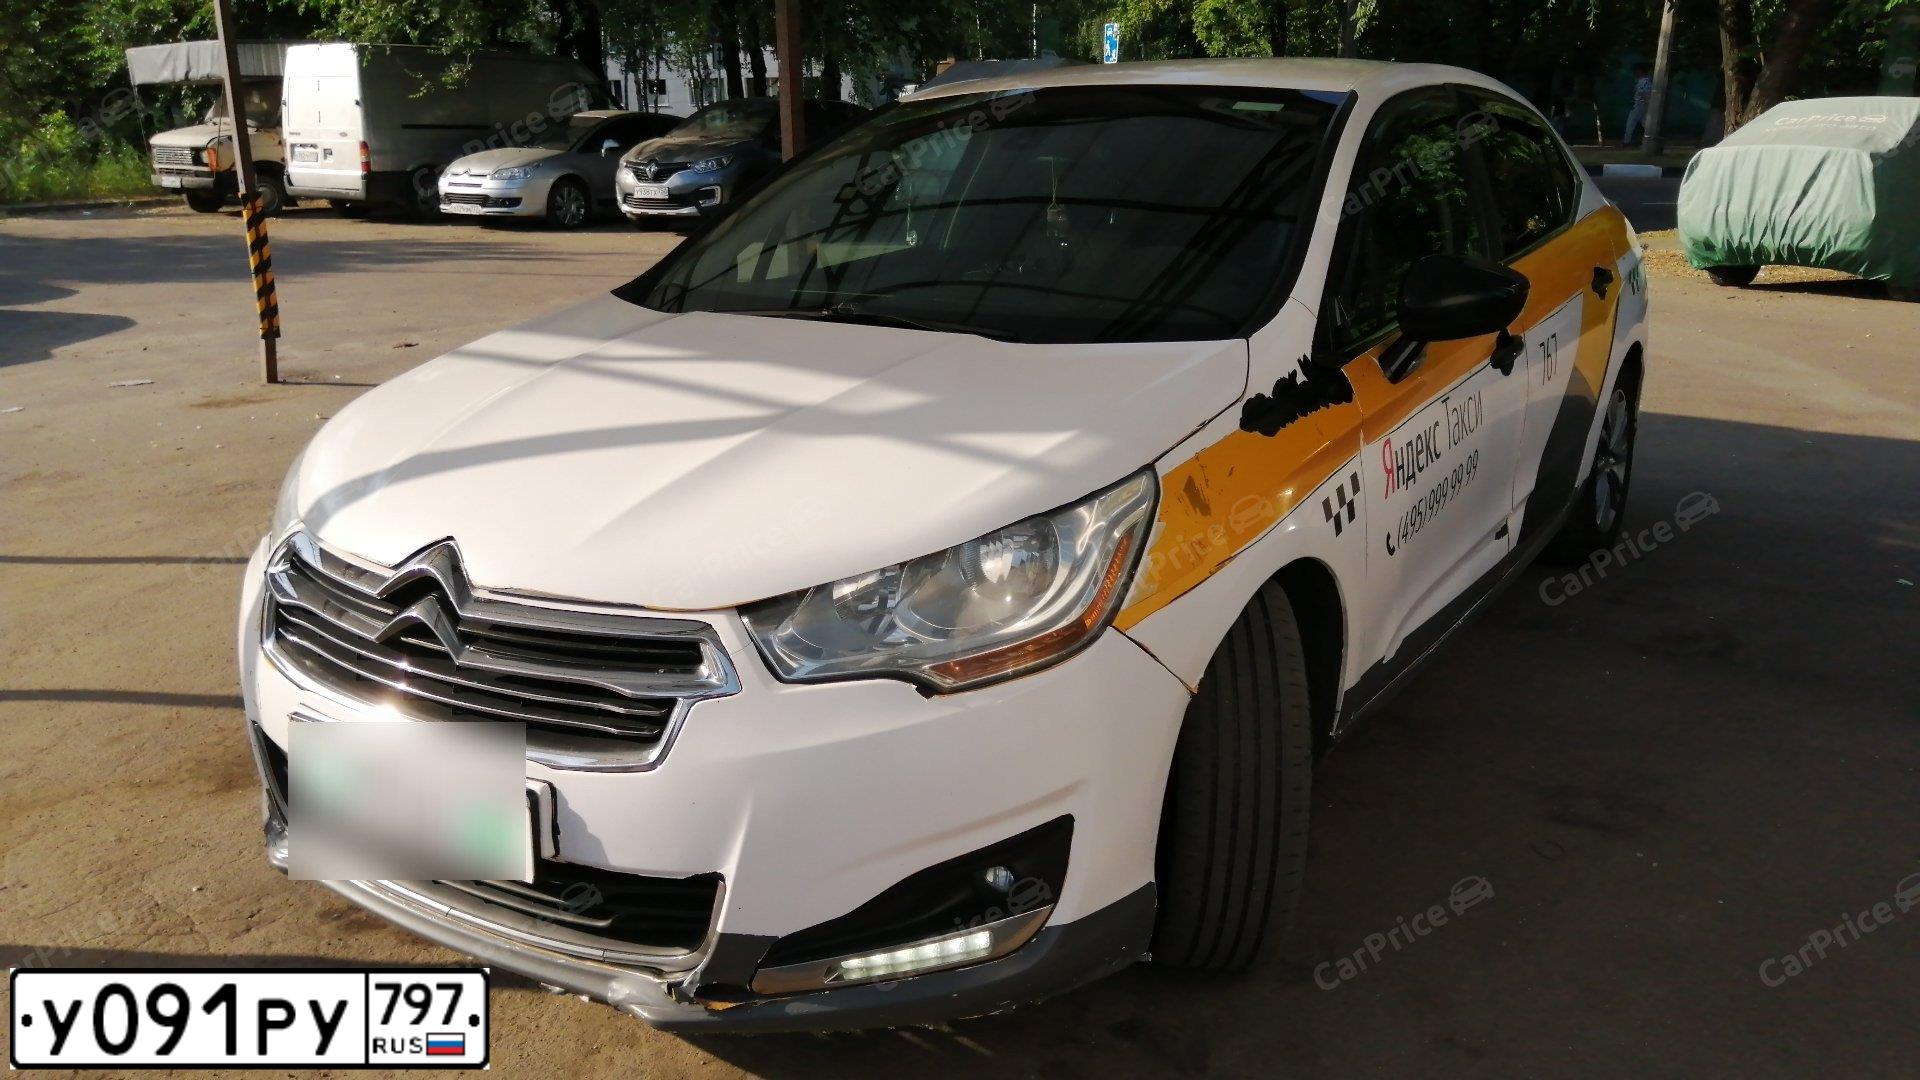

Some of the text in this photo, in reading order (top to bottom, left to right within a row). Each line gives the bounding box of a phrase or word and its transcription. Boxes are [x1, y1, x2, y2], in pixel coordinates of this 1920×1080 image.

[1538, 332, 1558, 386] 767
[1382, 390, 1483, 500] Яндекс Такси
